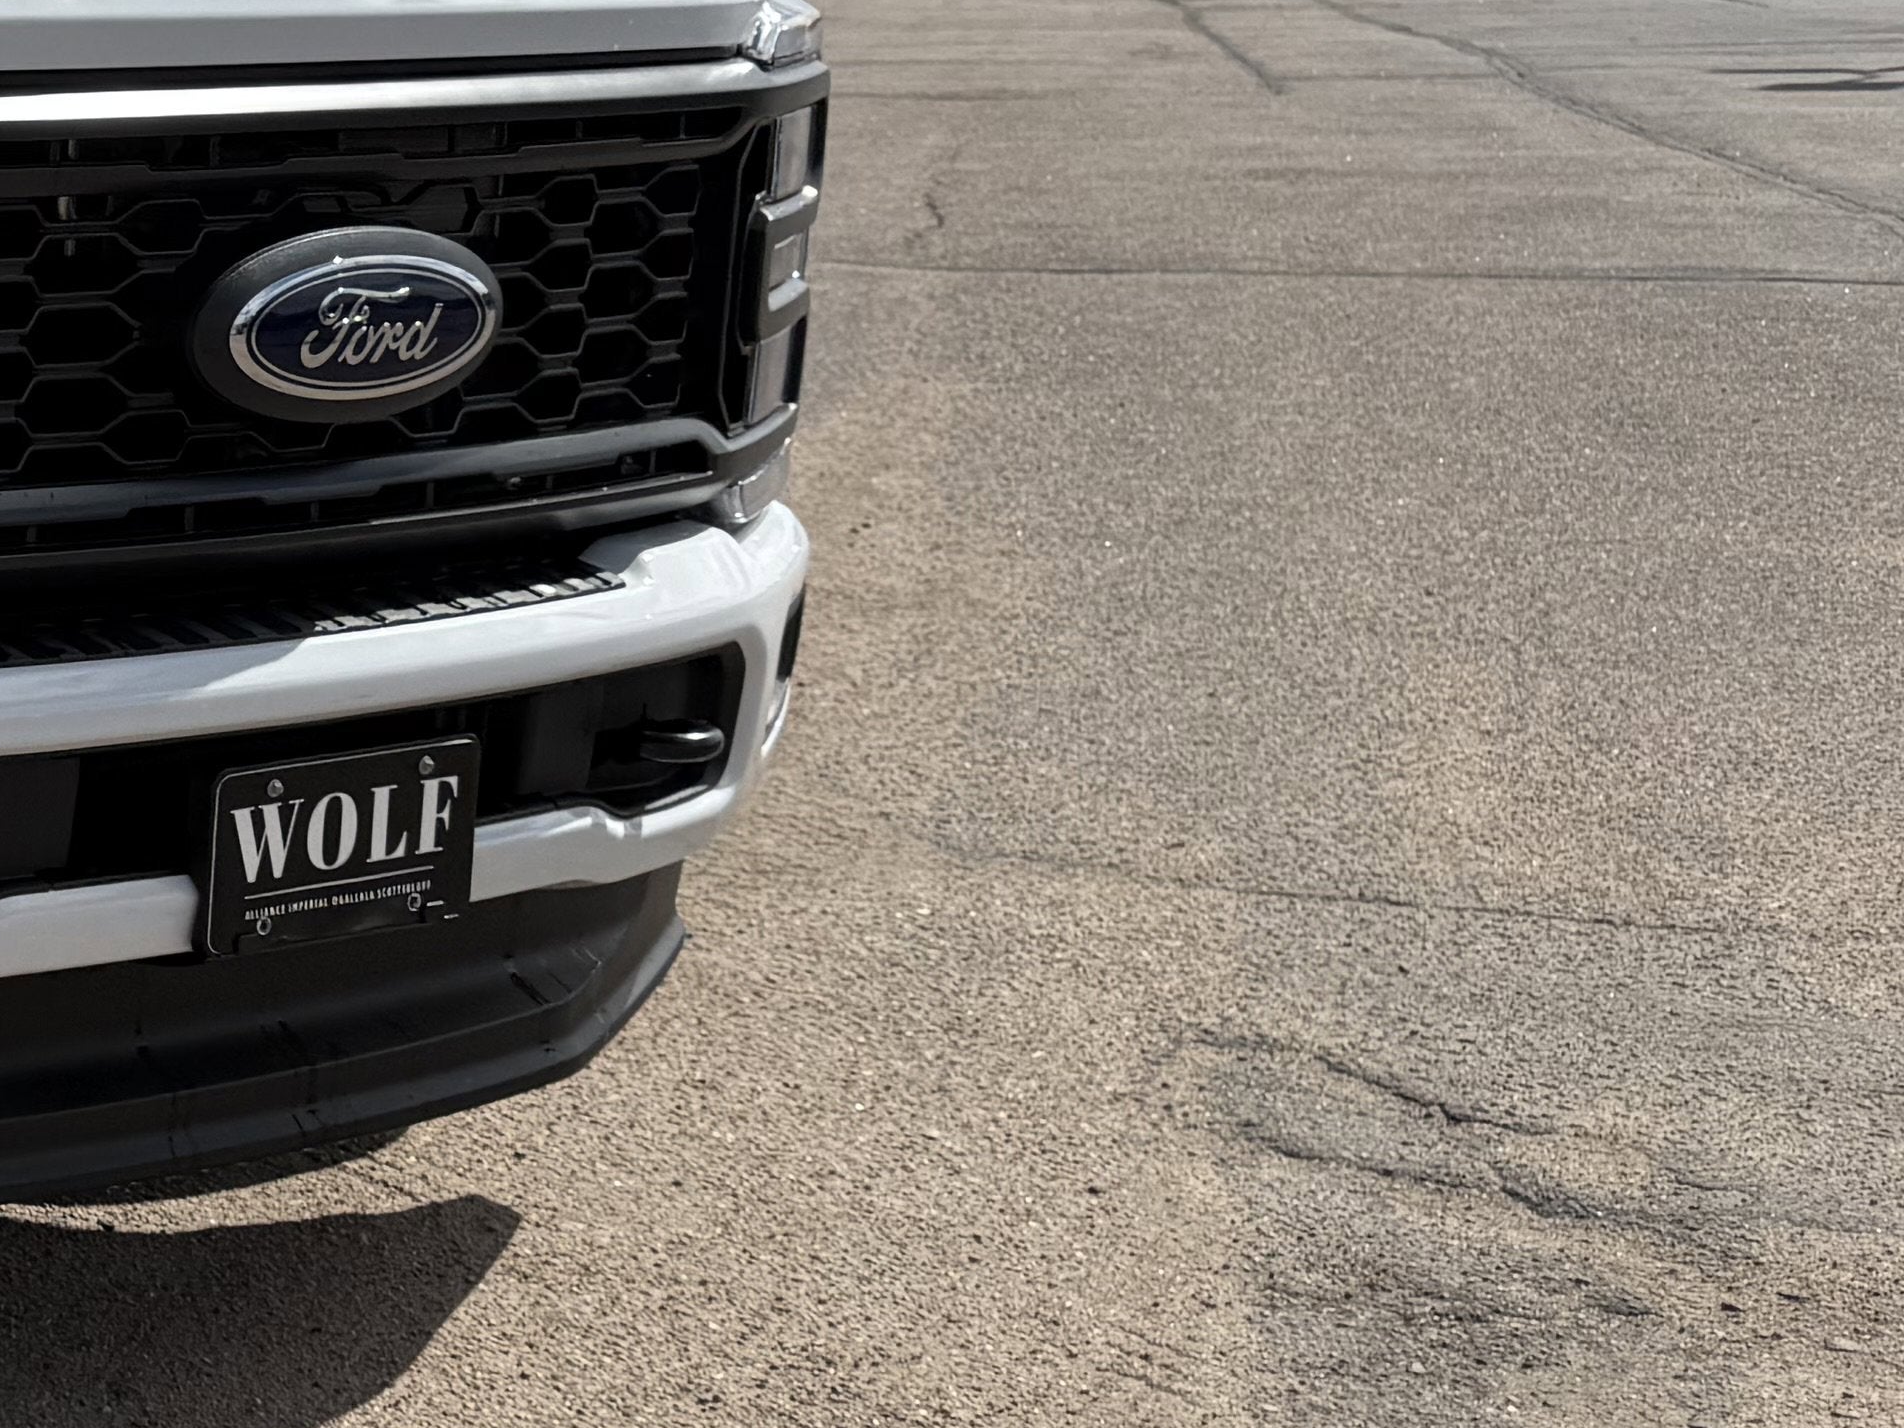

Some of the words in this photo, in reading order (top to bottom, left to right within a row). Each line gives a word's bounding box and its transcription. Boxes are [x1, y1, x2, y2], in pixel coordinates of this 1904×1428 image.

[300, 285, 445, 369] Ford
[229, 775, 459, 884] WOLF
[244, 904, 286, 920] ALLIANCE
[288, 897, 328, 913] IMPERIAL
